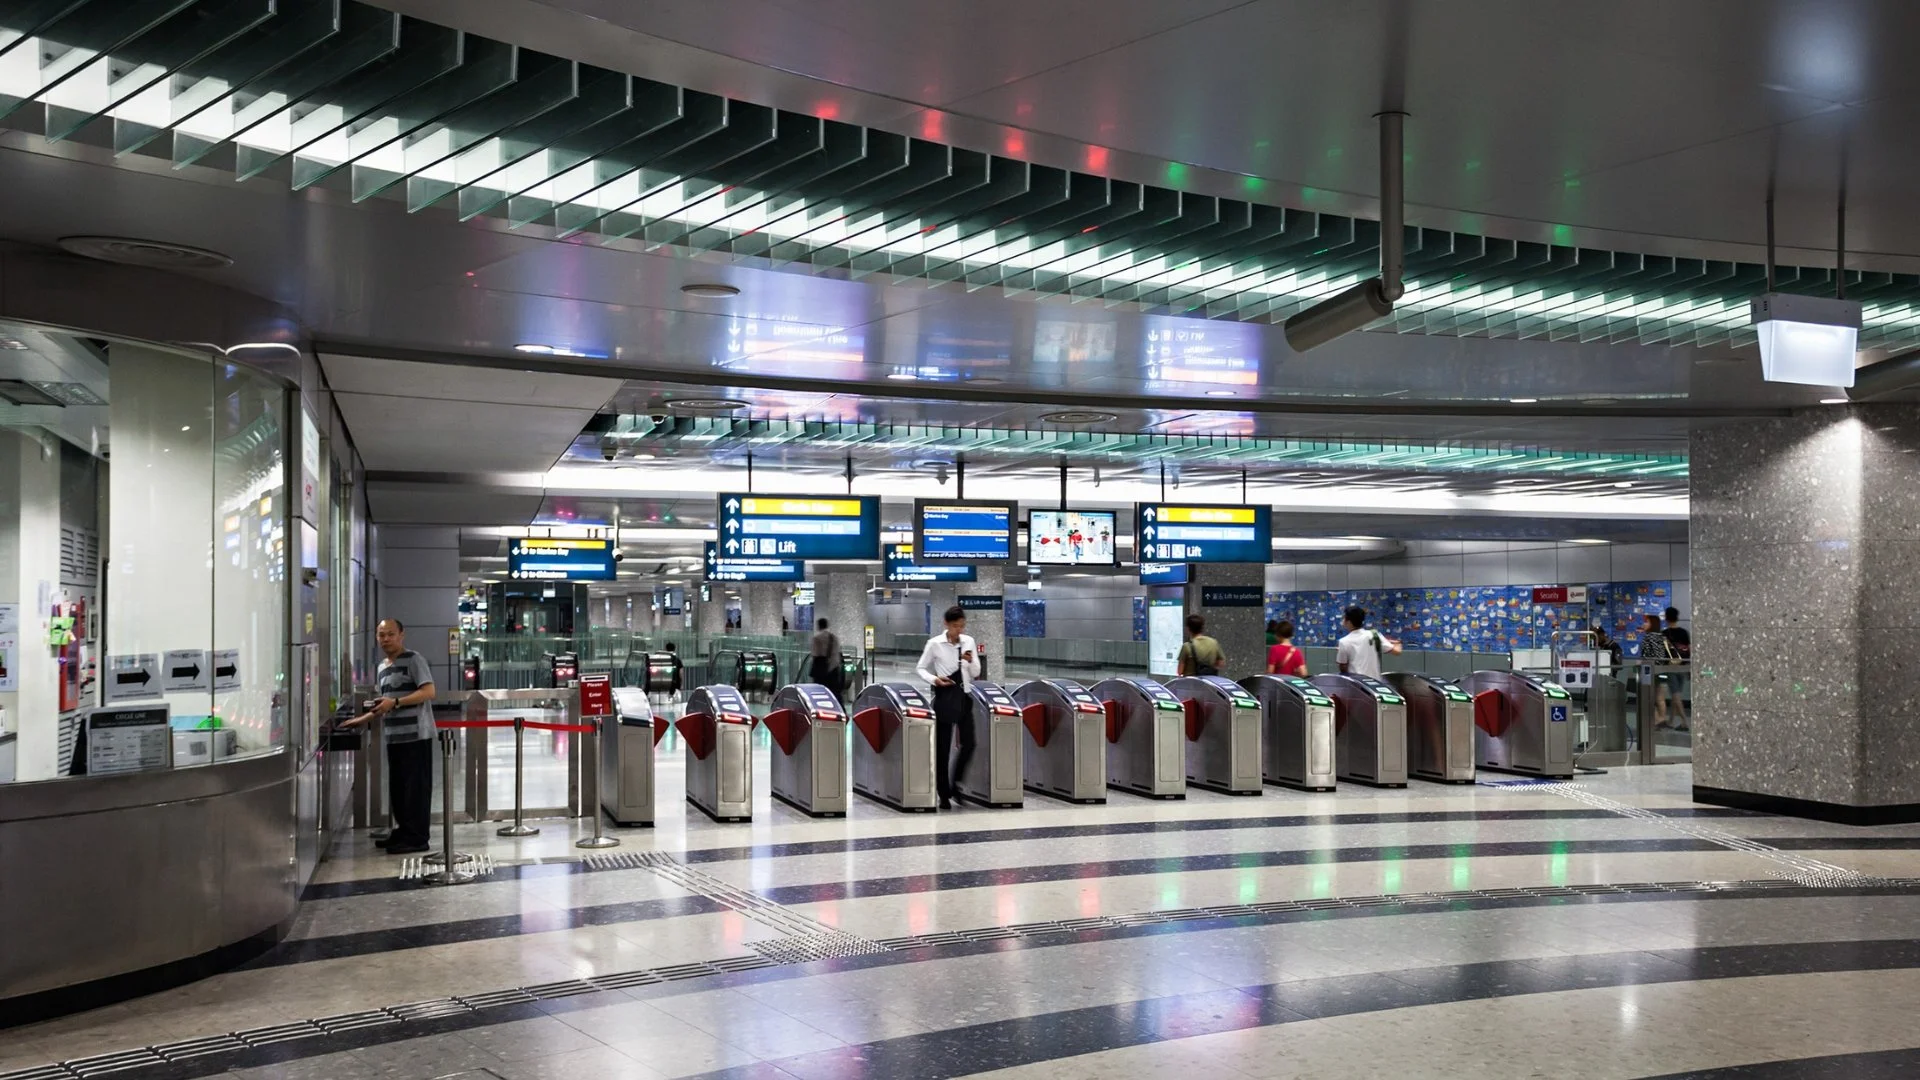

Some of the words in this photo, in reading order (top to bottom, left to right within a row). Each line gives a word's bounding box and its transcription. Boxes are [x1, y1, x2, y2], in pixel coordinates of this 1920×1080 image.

[778, 541, 797, 553] Lift
[1186, 546, 1202, 557] Lift
[1540, 592, 1559, 600] Security
